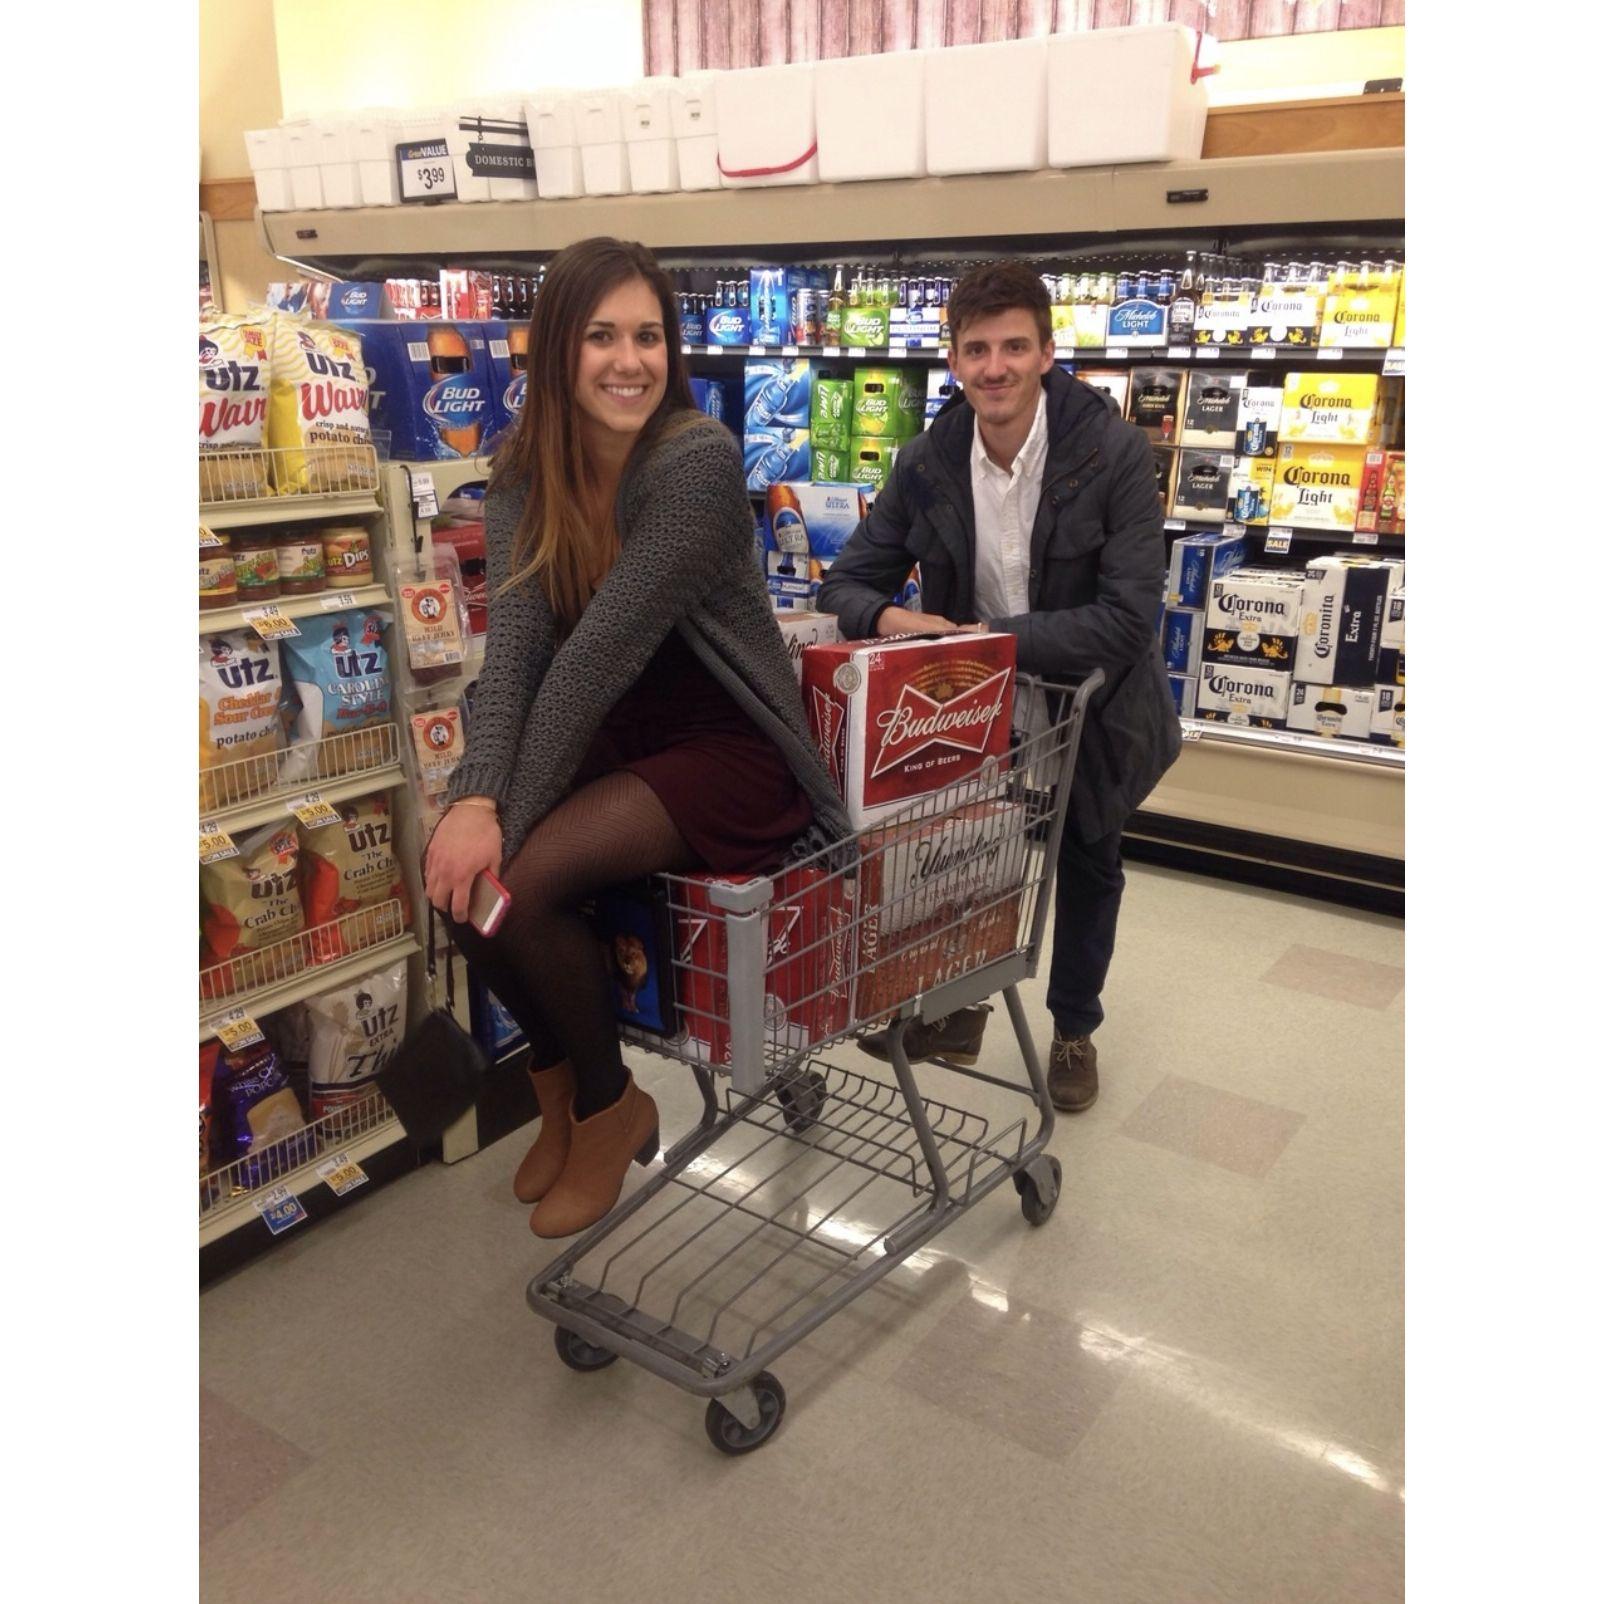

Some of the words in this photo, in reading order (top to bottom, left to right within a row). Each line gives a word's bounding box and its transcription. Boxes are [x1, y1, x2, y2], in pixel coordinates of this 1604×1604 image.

[475, 155, 524, 167] DOMESTIC
[1262, 300, 1303, 313] Corona
[720, 315, 742, 324] BUD
[854, 318, 882, 326] BUD
[1122, 320, 1149, 328] LIGHT
[1334, 310, 1381, 325] Corona
[715, 324, 745, 332] LIGHT
[850, 325, 884, 334] LIGHT
[1344, 325, 1369, 337] Light
[442, 386, 480, 400] BUD
[434, 399, 486, 413] LIGHT
[858, 405, 888, 413] LIGHT
[865, 398, 887, 406] BUD
[1202, 405, 1224, 413] LAGER
[1300, 393, 1353, 411] Corona
[1310, 410, 1338, 425] Light
[310, 431, 350, 447] potato
[861, 466, 882, 474] BUD
[1283, 465, 1351, 490] Corona
[1192, 482, 1214, 490] LAGER
[1297, 487, 1333, 506] Light
[1267, 540, 1285, 548] SALE
[1218, 592, 1286, 616] Corona
[1239, 612, 1262, 623] Extra
[1314, 594, 1336, 659] Coronita
[1345, 610, 1362, 642] Extra
[869, 653, 882, 665] 24
[1208, 674, 1275, 699] Corona
[341, 691, 385, 706] STYLE
[1229, 694, 1252, 704] Extra
[213, 709, 250, 727] Sour
[877, 698, 1003, 747] Budweiser
[216, 731, 257, 750] potato
[904, 763, 923, 773] KING
[925, 760, 936, 768] OF
[937, 754, 961, 766] BEERS
[202, 835, 226, 850] 5.00
[343, 862, 375, 881] Crab
[244, 909, 276, 928] Crab
[369, 1027, 394, 1047] EXTRA
